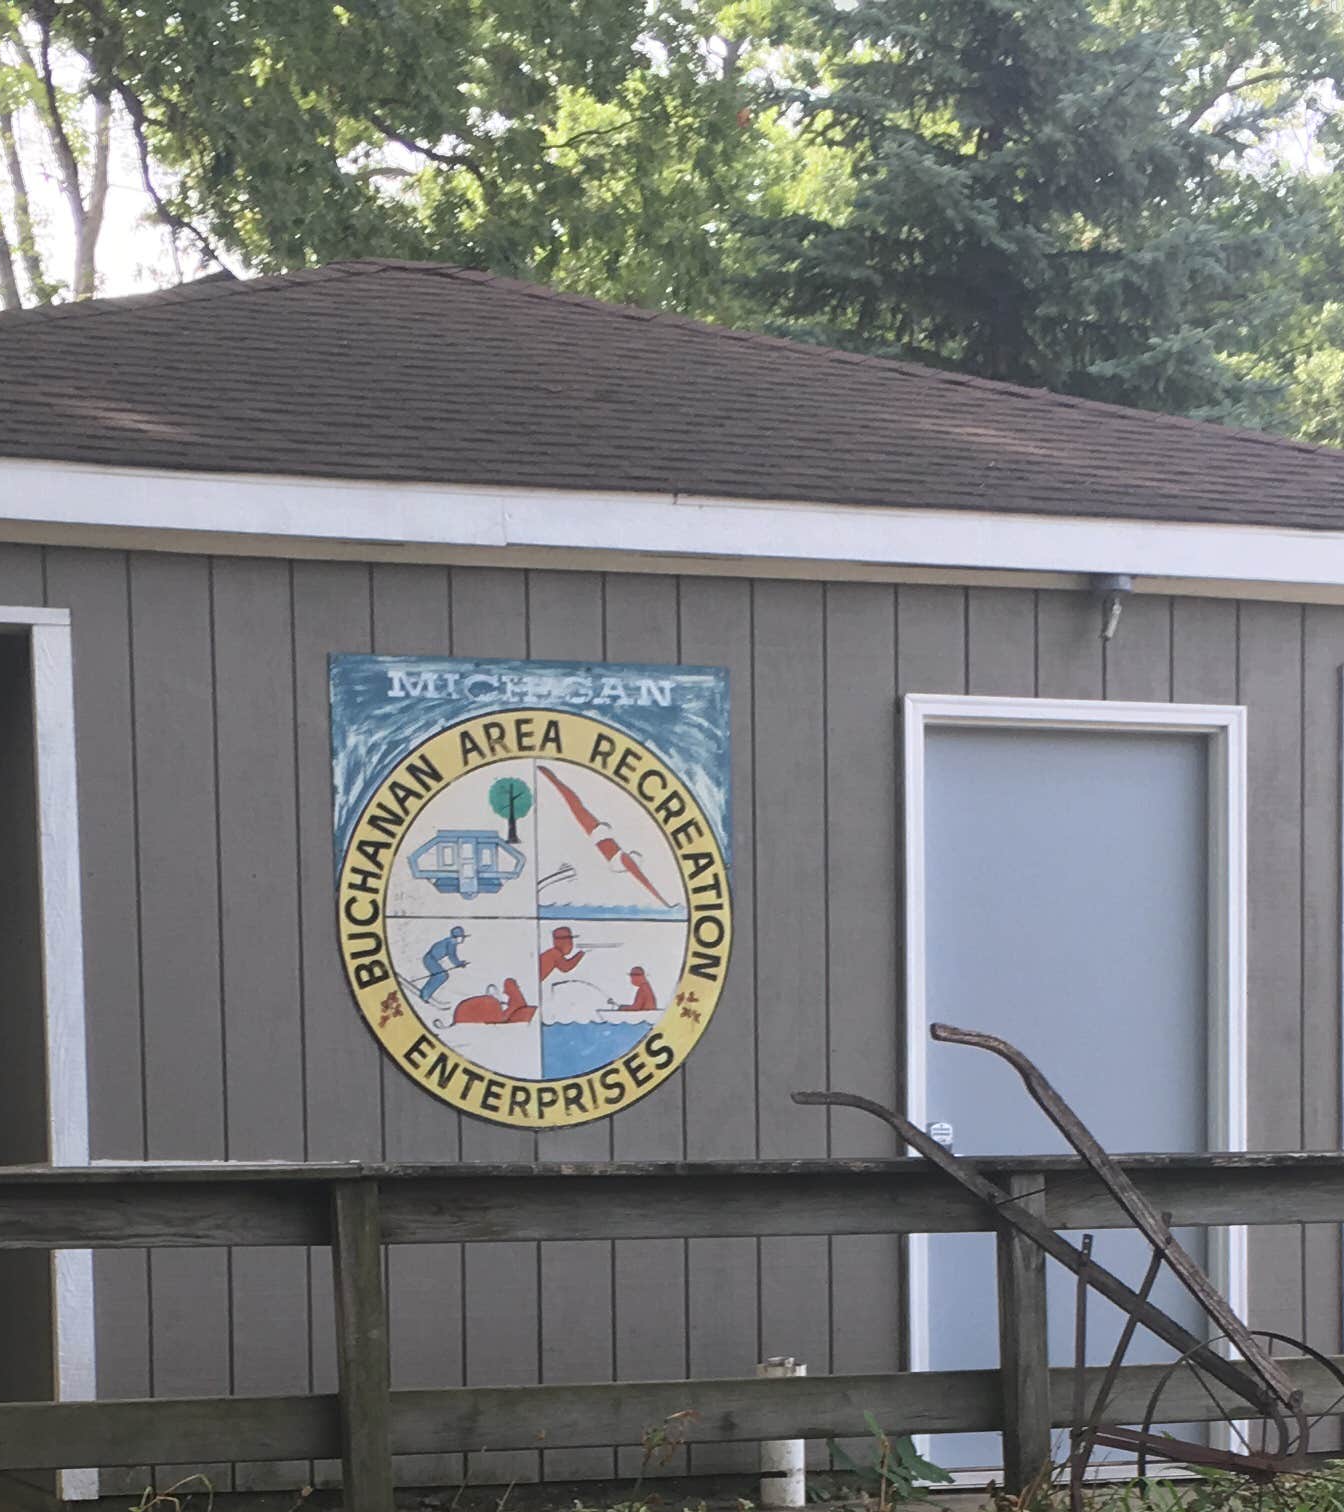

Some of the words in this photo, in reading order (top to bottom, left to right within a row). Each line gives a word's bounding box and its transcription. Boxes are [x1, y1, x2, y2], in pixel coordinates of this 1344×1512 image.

[385, 670, 677, 707] MICHIGAN
[344, 753, 444, 989] BUCHANAN
[459, 718, 563, 767] AREA
[589, 732, 725, 982] RECREATION
[402, 1031, 675, 1119] ENTERPRISES
